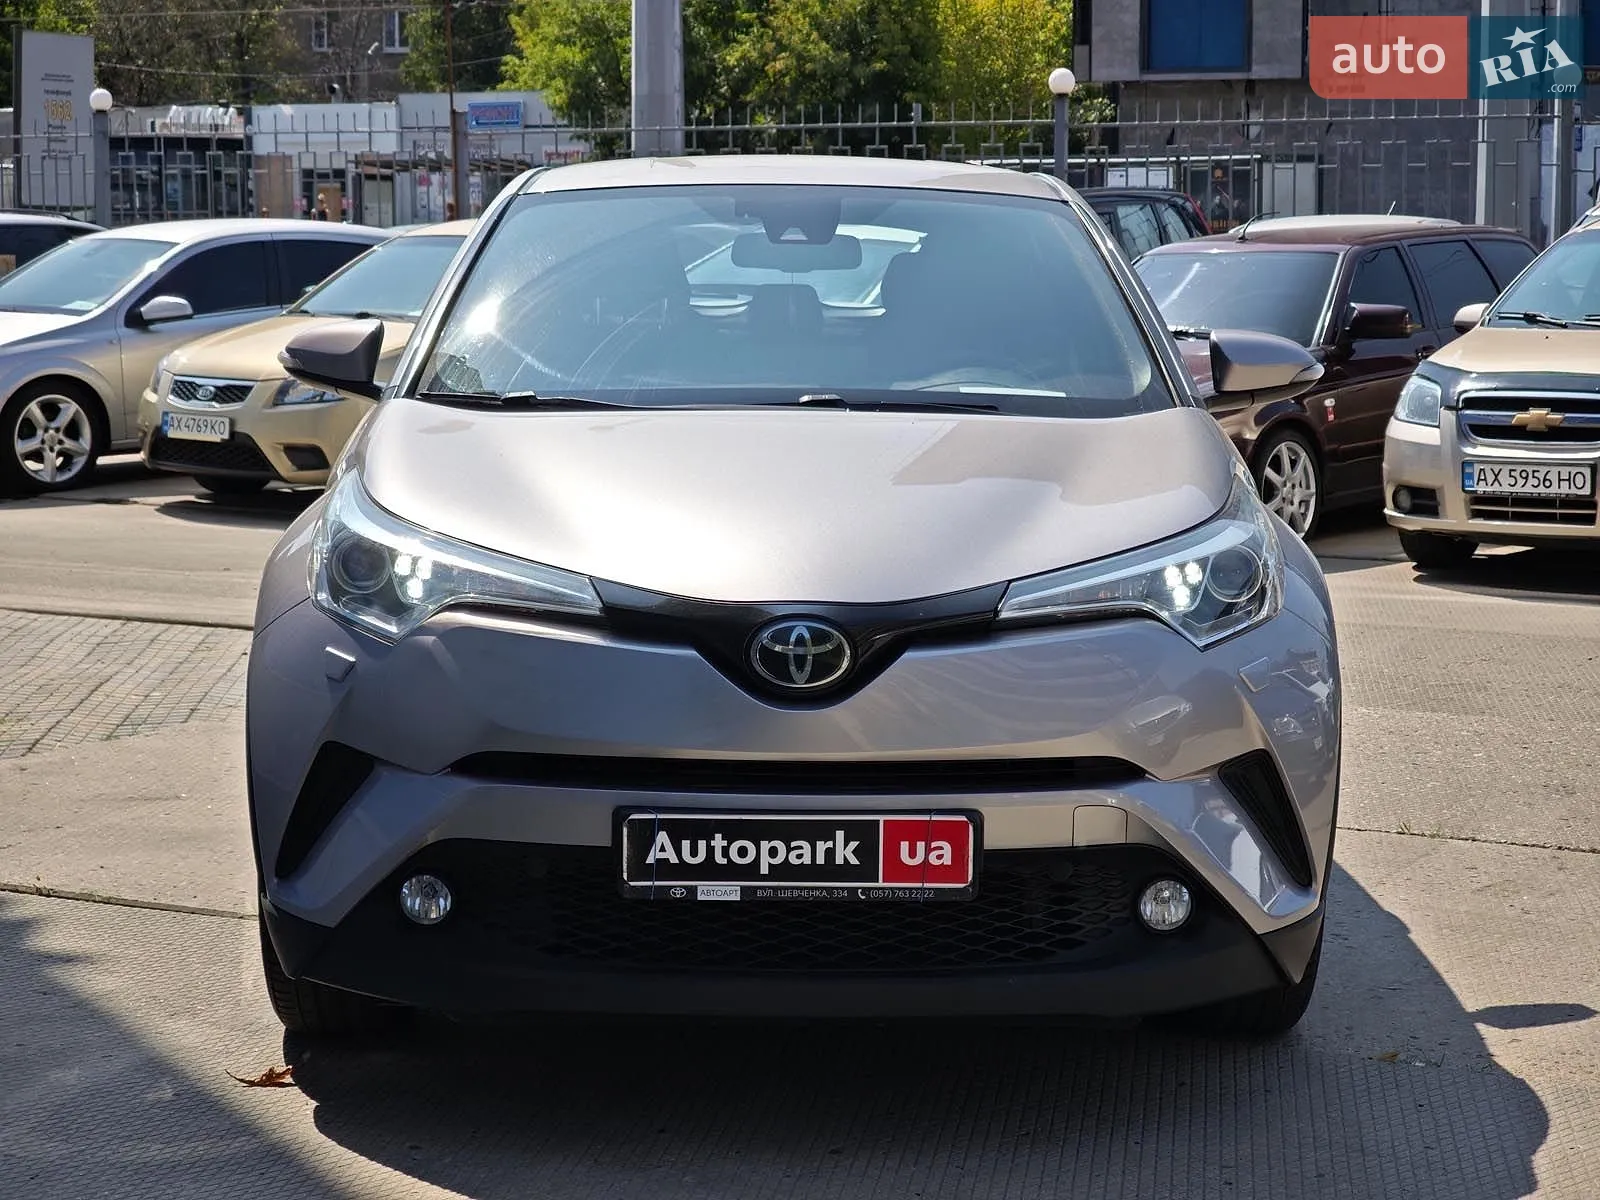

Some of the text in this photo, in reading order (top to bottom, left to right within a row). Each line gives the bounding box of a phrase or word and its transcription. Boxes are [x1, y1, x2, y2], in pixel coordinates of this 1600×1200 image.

[184, 417, 208, 433] 4769
[210, 419, 226, 435] KO
[1476, 468, 1586, 490] AX 5956 HO
[645, 830, 952, 875] Autopark ua
[699, 888, 740, 898] АВТОАРТ
[778, 888, 830, 898] ШЕВЧЕНКА,
[832, 889, 848, 897] 334
[870, 888, 892, 898] (057)
[894, 889, 909, 897] 763
[911, 889, 922, 897] 22
[924, 889, 935, 897] 22
